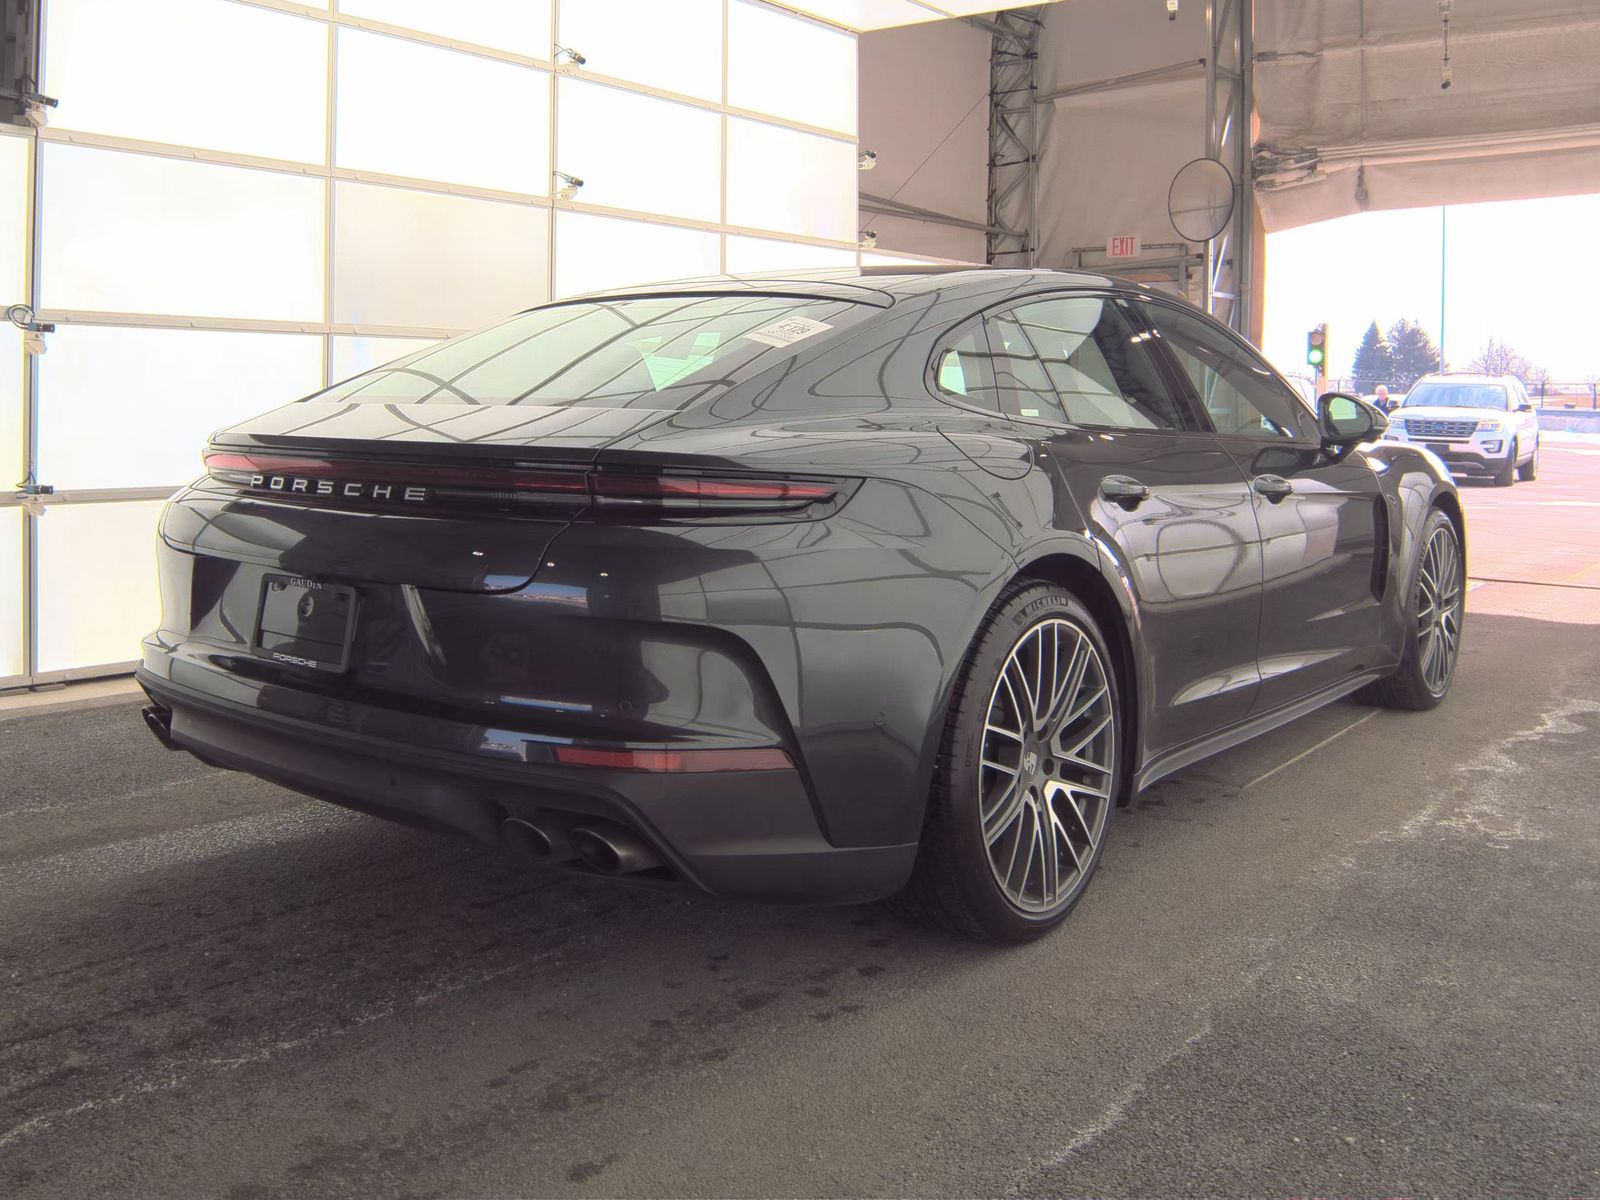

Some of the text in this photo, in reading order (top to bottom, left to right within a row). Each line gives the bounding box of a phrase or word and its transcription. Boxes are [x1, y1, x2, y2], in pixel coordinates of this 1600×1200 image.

[1112, 236, 1136, 256] EXIT
[250, 475, 426, 501] PORSCHE
[290, 578, 322, 590] GAUDIN
[1024, 596, 1067, 614] MICHELIN
[273, 652, 317, 668] PORSCHE
